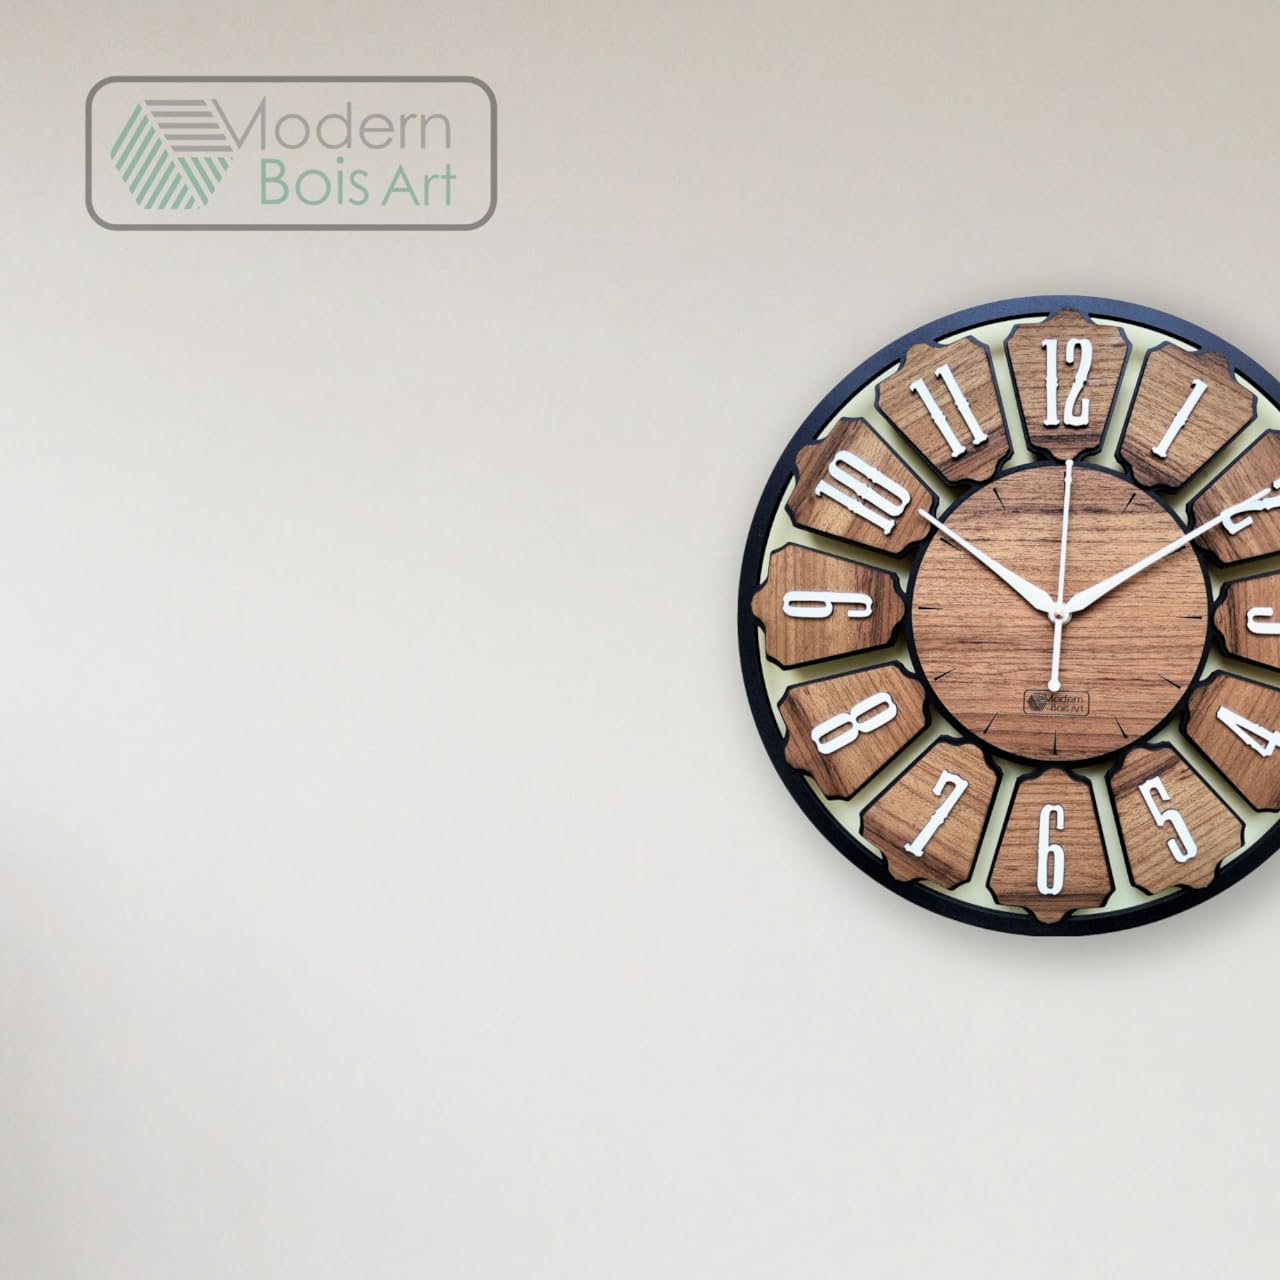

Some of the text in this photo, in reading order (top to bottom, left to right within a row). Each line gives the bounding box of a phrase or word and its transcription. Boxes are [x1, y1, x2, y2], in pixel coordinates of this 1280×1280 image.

[909, 363, 988, 458] 11
[1042, 338, 1093, 428] 12
[1151, 378, 1207, 458] 1
[814, 450, 911, 536] 10
[782, 590, 873, 619] 9
[811, 692, 897, 755] 8
[904, 770, 969, 857] 7
[1036, 804, 1065, 896] 6
[1138, 776, 1197, 863] 5
